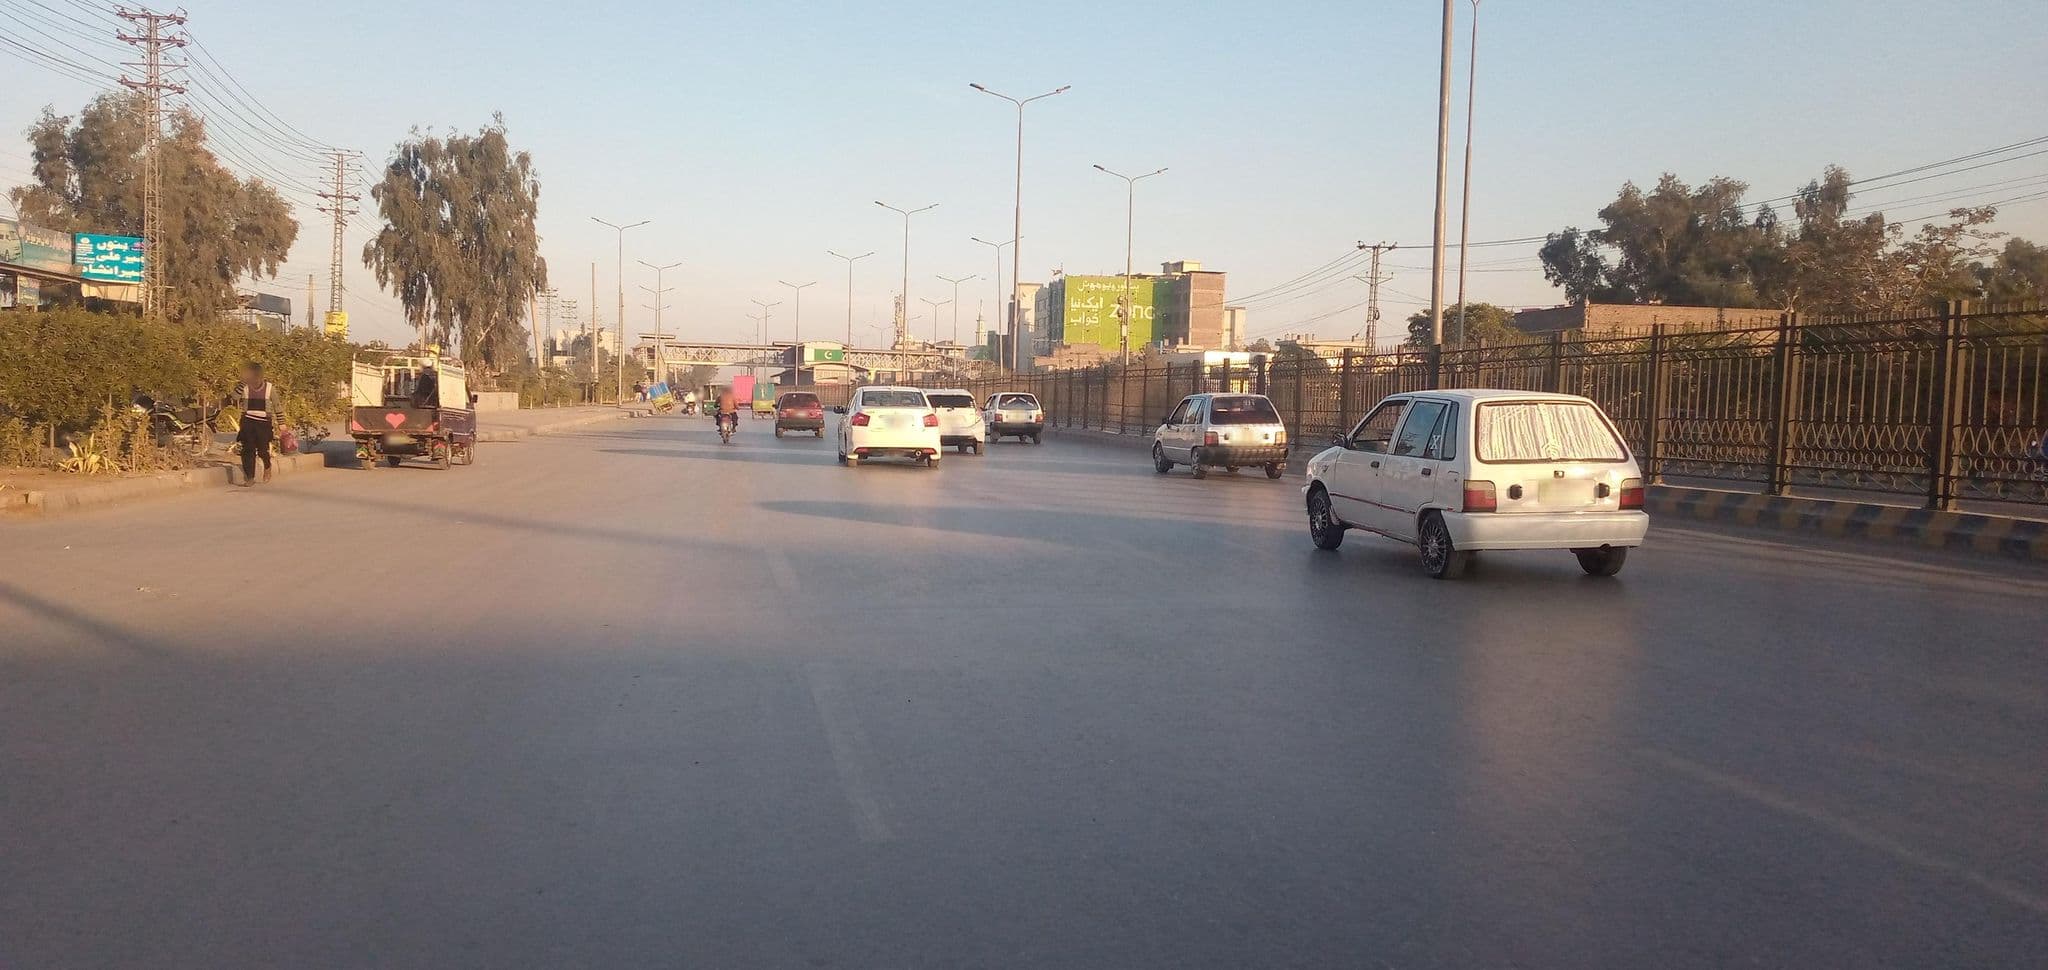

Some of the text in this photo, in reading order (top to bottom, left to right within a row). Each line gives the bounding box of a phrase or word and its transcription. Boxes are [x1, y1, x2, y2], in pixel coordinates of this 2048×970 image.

[96, 251, 121, 262] علی
[1070, 296, 1103, 311] ایک نیا
[1071, 312, 1099, 325] خواب
